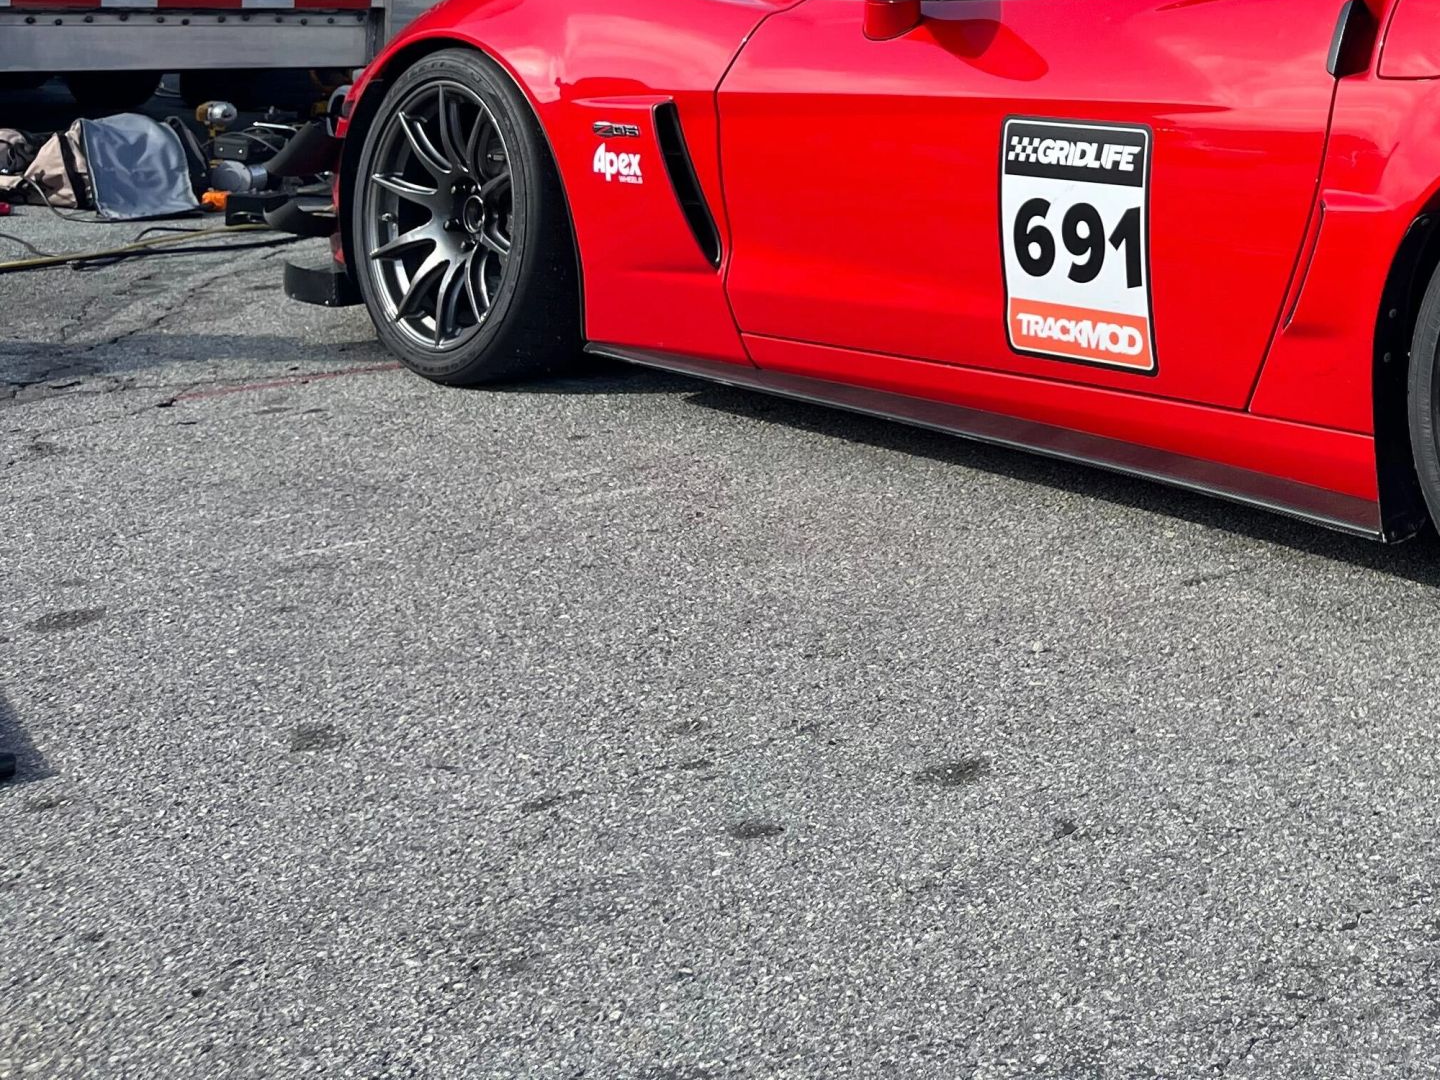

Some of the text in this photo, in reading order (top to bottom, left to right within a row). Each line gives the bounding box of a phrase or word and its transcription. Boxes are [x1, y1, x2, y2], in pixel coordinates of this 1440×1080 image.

[593, 142, 642, 182] Apex
[1036, 138, 1142, 172] GRIDLIFE
[1013, 197, 1143, 289] 691
[1016, 313, 1144, 356] TRACKMOD
